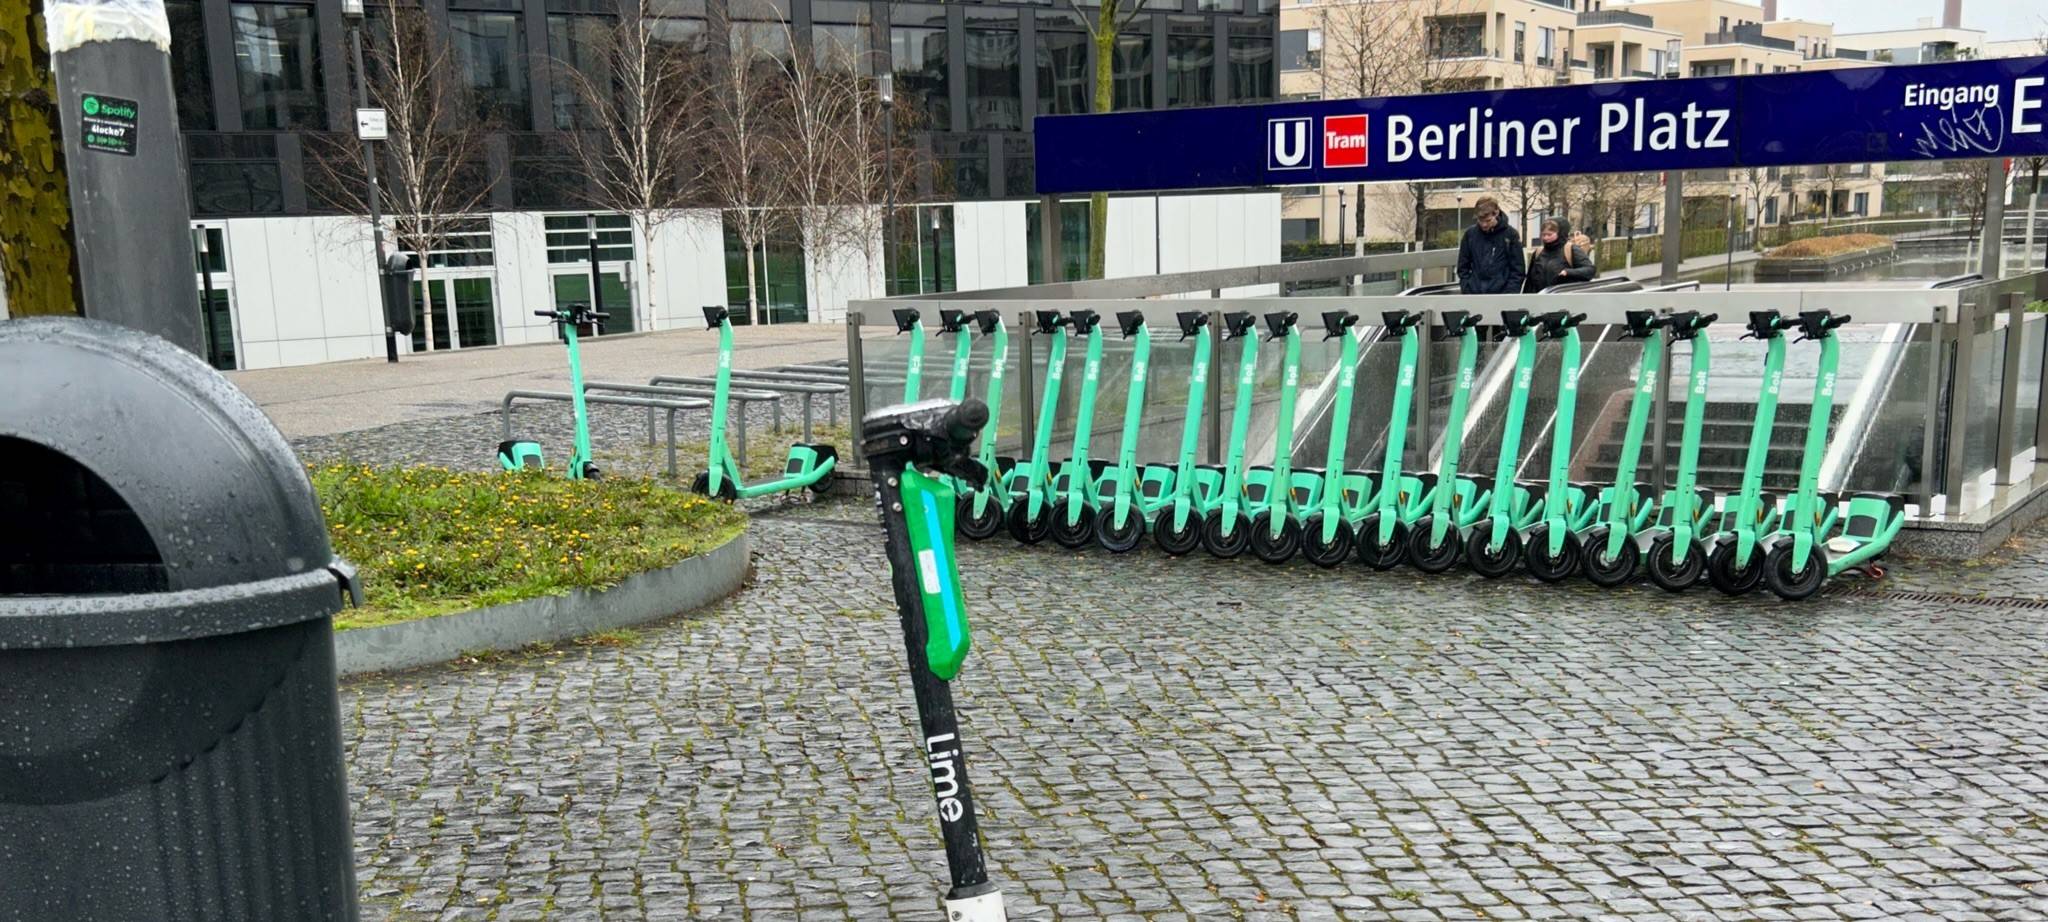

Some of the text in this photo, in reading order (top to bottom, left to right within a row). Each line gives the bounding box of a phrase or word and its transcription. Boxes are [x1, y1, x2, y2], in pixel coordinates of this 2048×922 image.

[101, 104, 135, 119] Spotify
[1904, 83, 1999, 111] Eingang
[2011, 77, 2045, 134] E
[1275, 98, 1730, 167] U Tram Berliner Platz
[1461, 368, 1472, 389] Bolt
[1519, 368, 1530, 389] Bolt
[1566, 368, 1577, 389] Bolt
[1643, 371, 1656, 393] Bolt
[1695, 371, 1707, 394] Bolt
[1768, 371, 1781, 394] Bolt
[1821, 373, 1834, 396] Bolt
[926, 733, 963, 822] Lime
